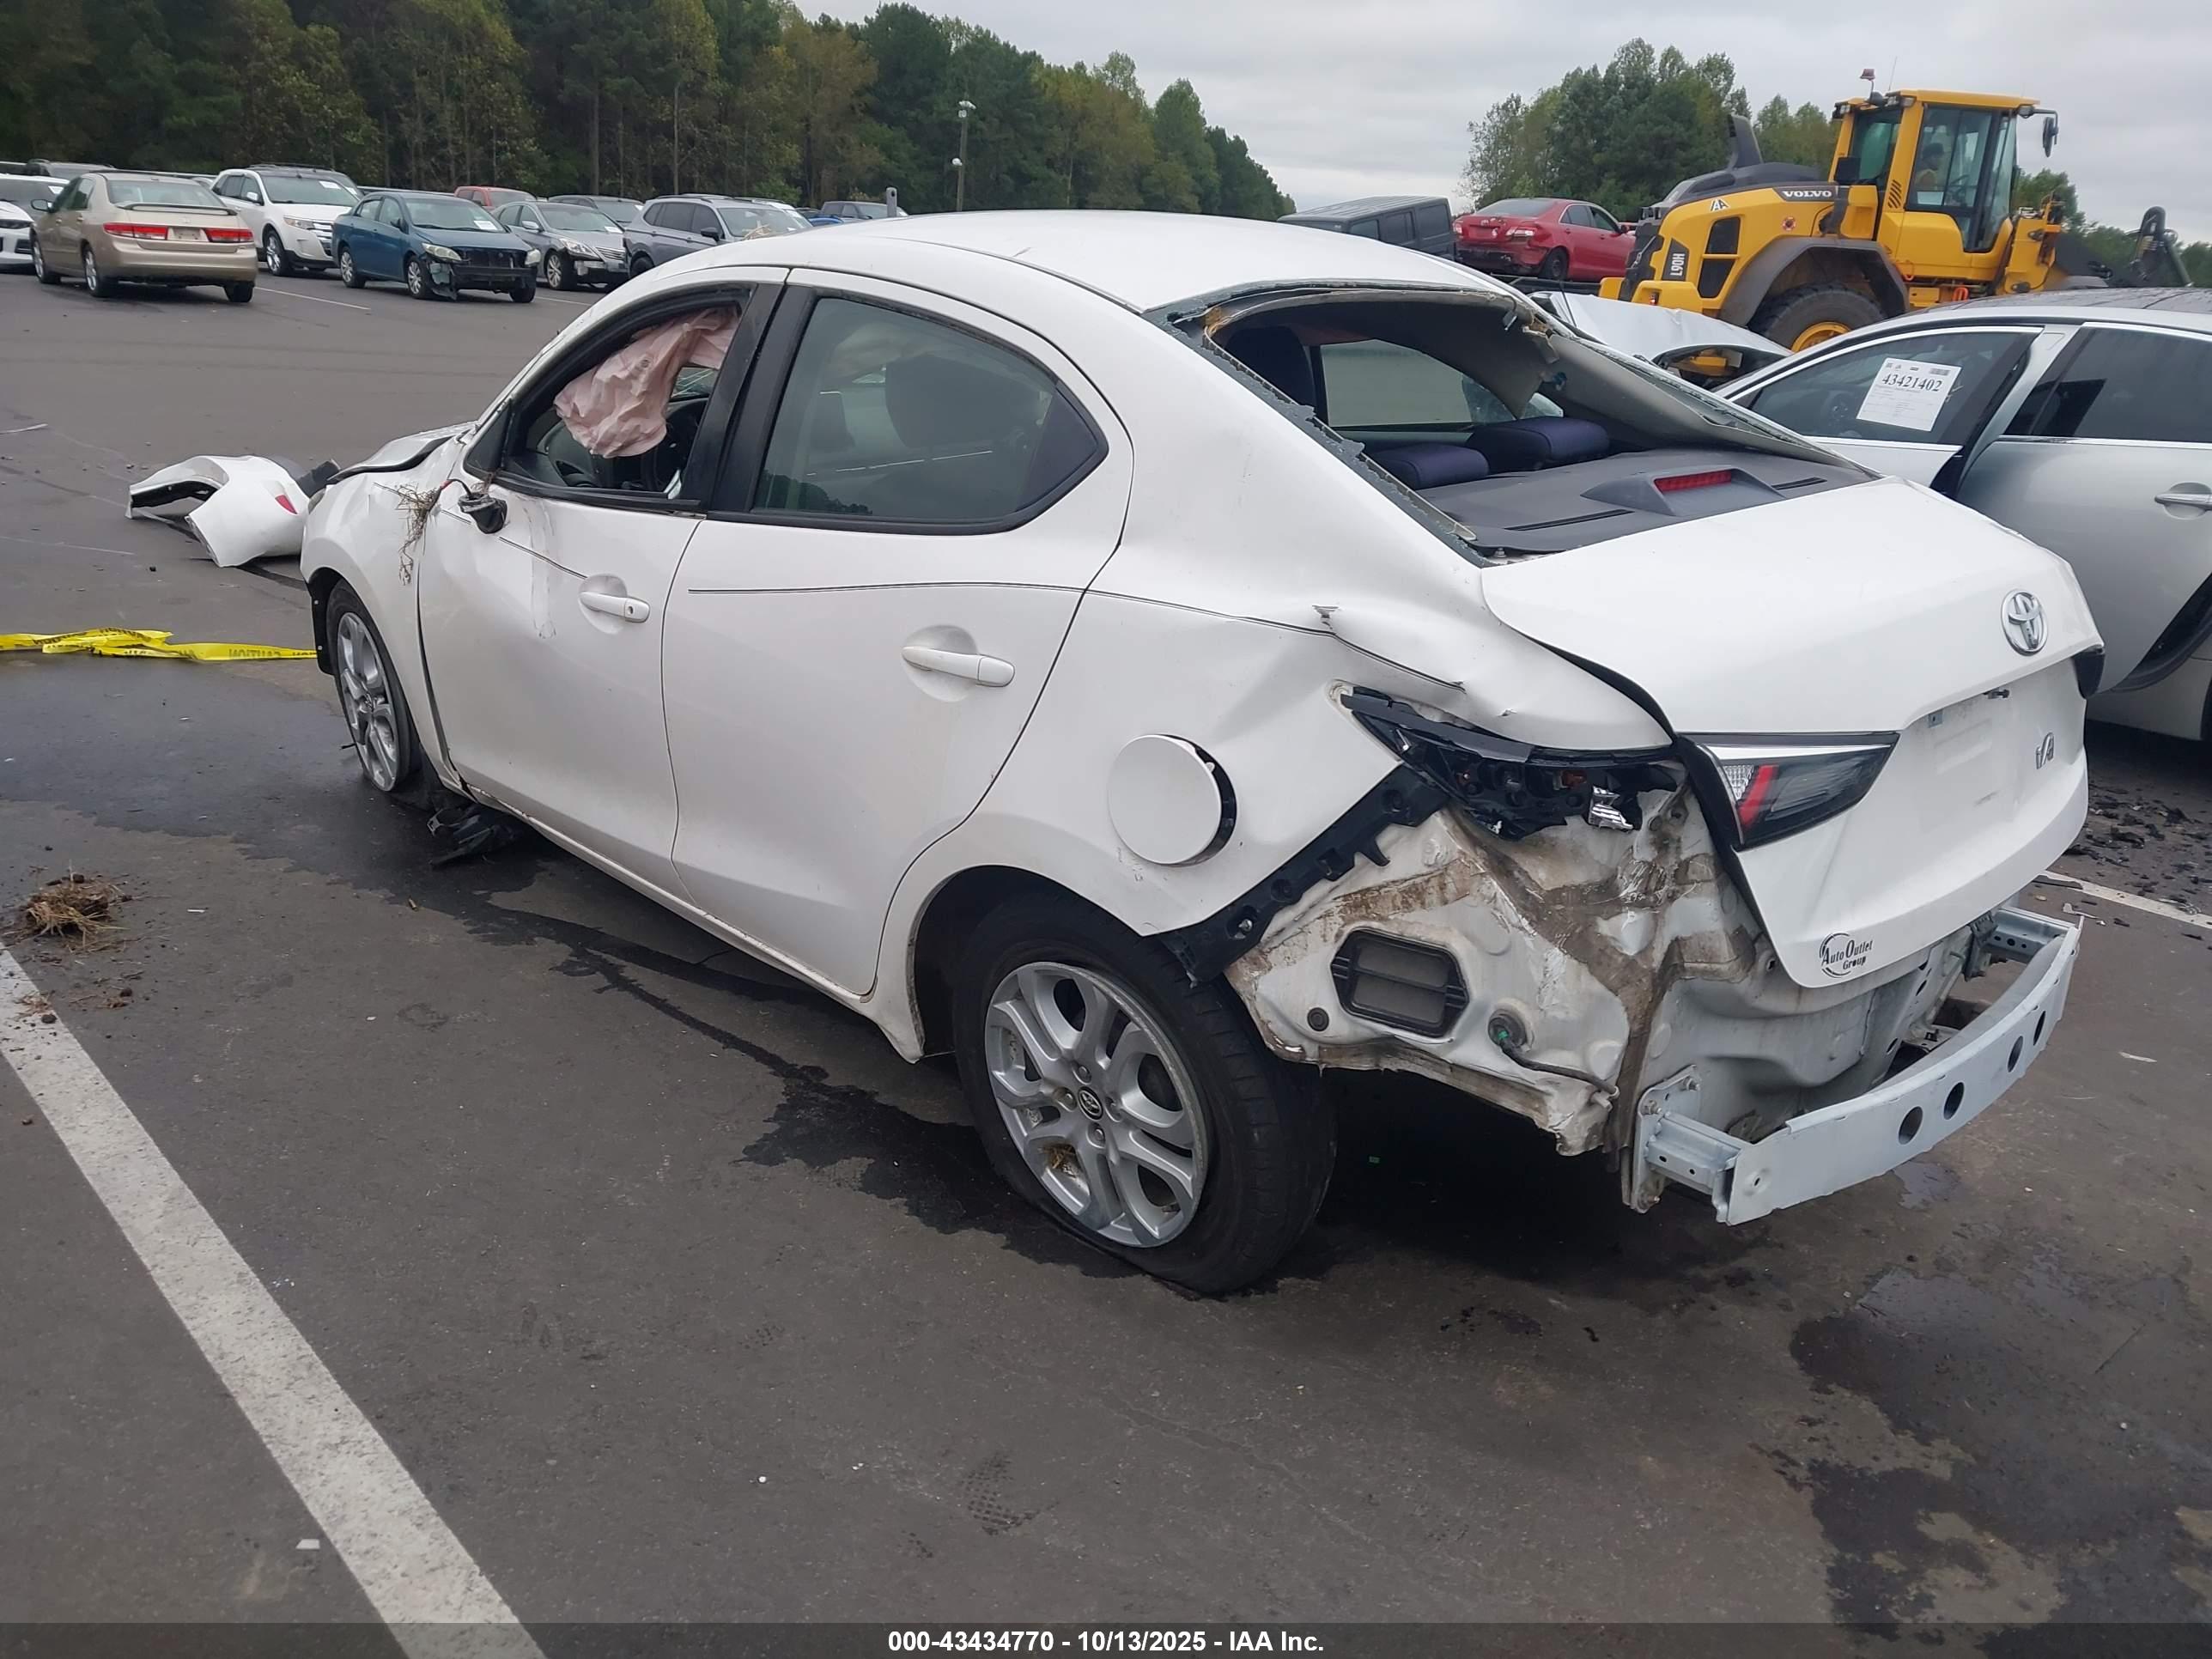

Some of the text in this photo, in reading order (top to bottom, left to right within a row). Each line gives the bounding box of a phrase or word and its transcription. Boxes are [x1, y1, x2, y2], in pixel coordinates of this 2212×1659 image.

[1670, 252, 1686, 276] L90H
[1882, 374, 1942, 392] 43421402
[1821, 939, 1874, 967] Auto Outlet
[1843, 955, 1866, 970] Group
